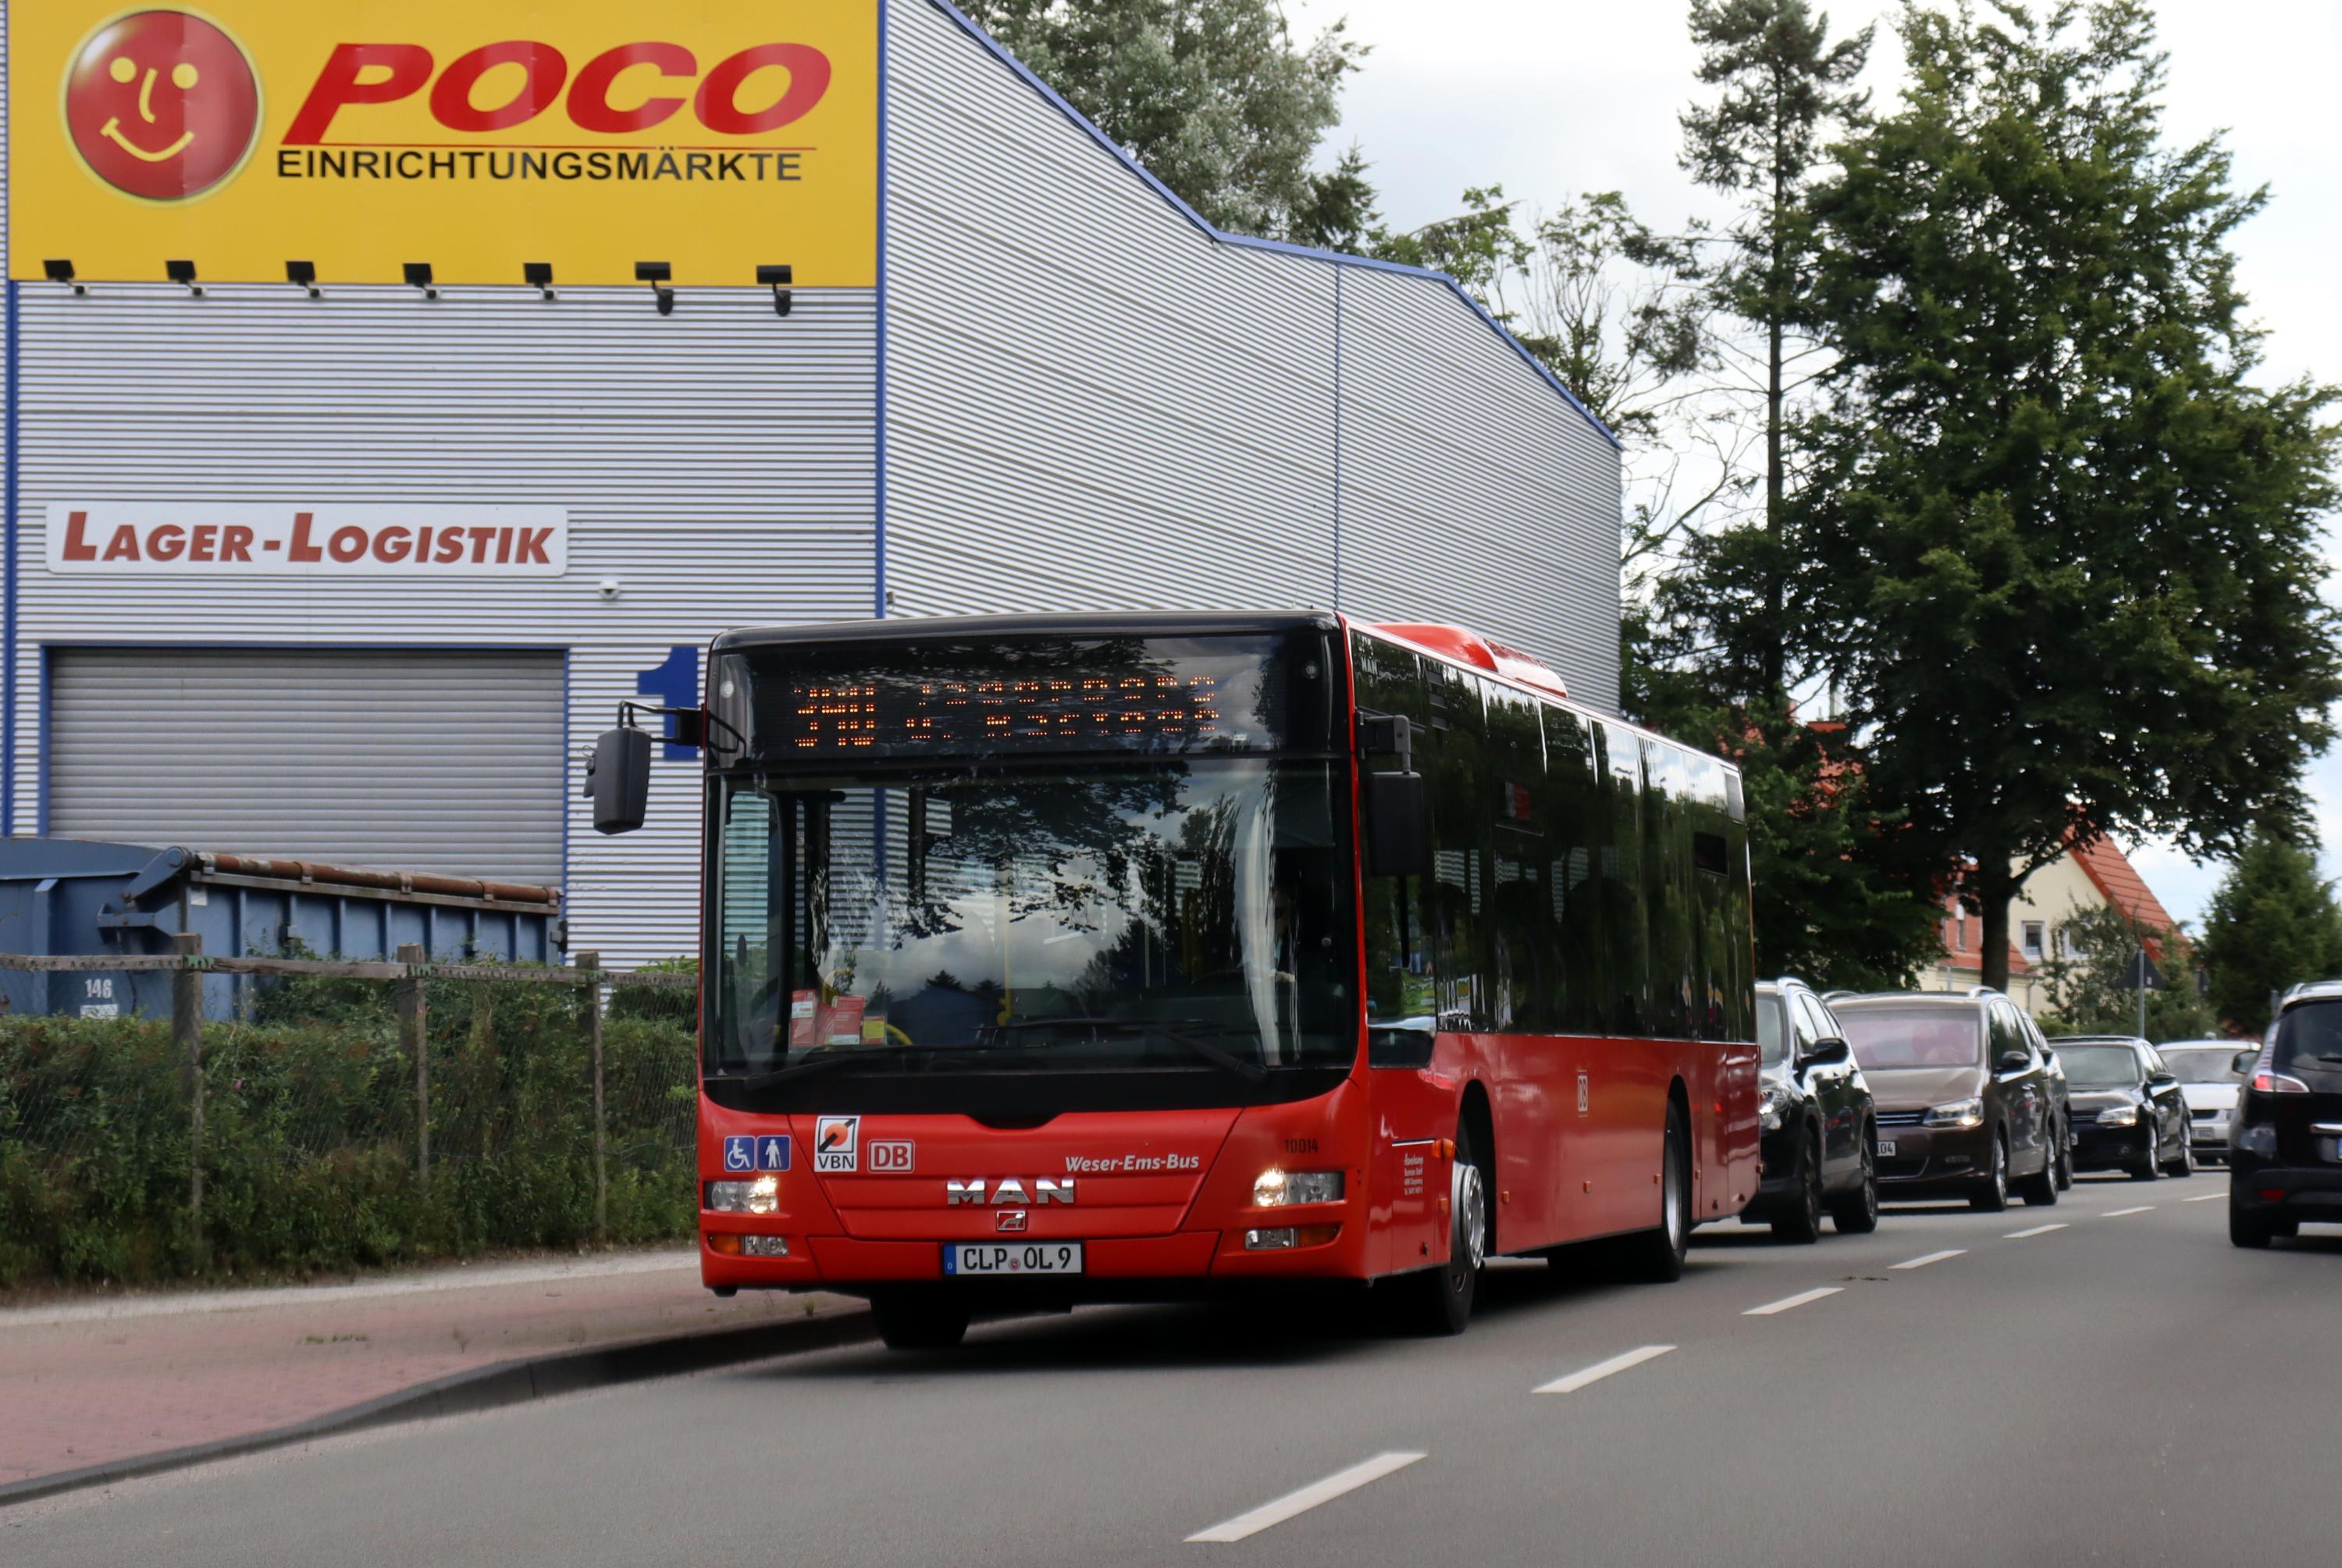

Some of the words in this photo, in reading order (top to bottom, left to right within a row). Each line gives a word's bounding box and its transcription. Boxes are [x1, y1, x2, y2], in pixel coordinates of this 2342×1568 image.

[280, 40, 832, 144] POCO
[277, 147, 803, 182] EINRICHTUNGSMÄRKTE
[637, 645, 699, 761] 1
[84, 979, 113, 999] 146
[874, 1145, 909, 1168] DB
[1284, 1138, 1319, 1154] 10014
[817, 1154, 855, 1169] VBN
[1065, 1154, 1201, 1172] Weser-Ems-Bus
[946, 1179, 1074, 1205] MAN
[963, 1247, 1008, 1271] CLP
[1023, 1246, 1053, 1270] OL
[1058, 1246, 1071, 1269] 9
